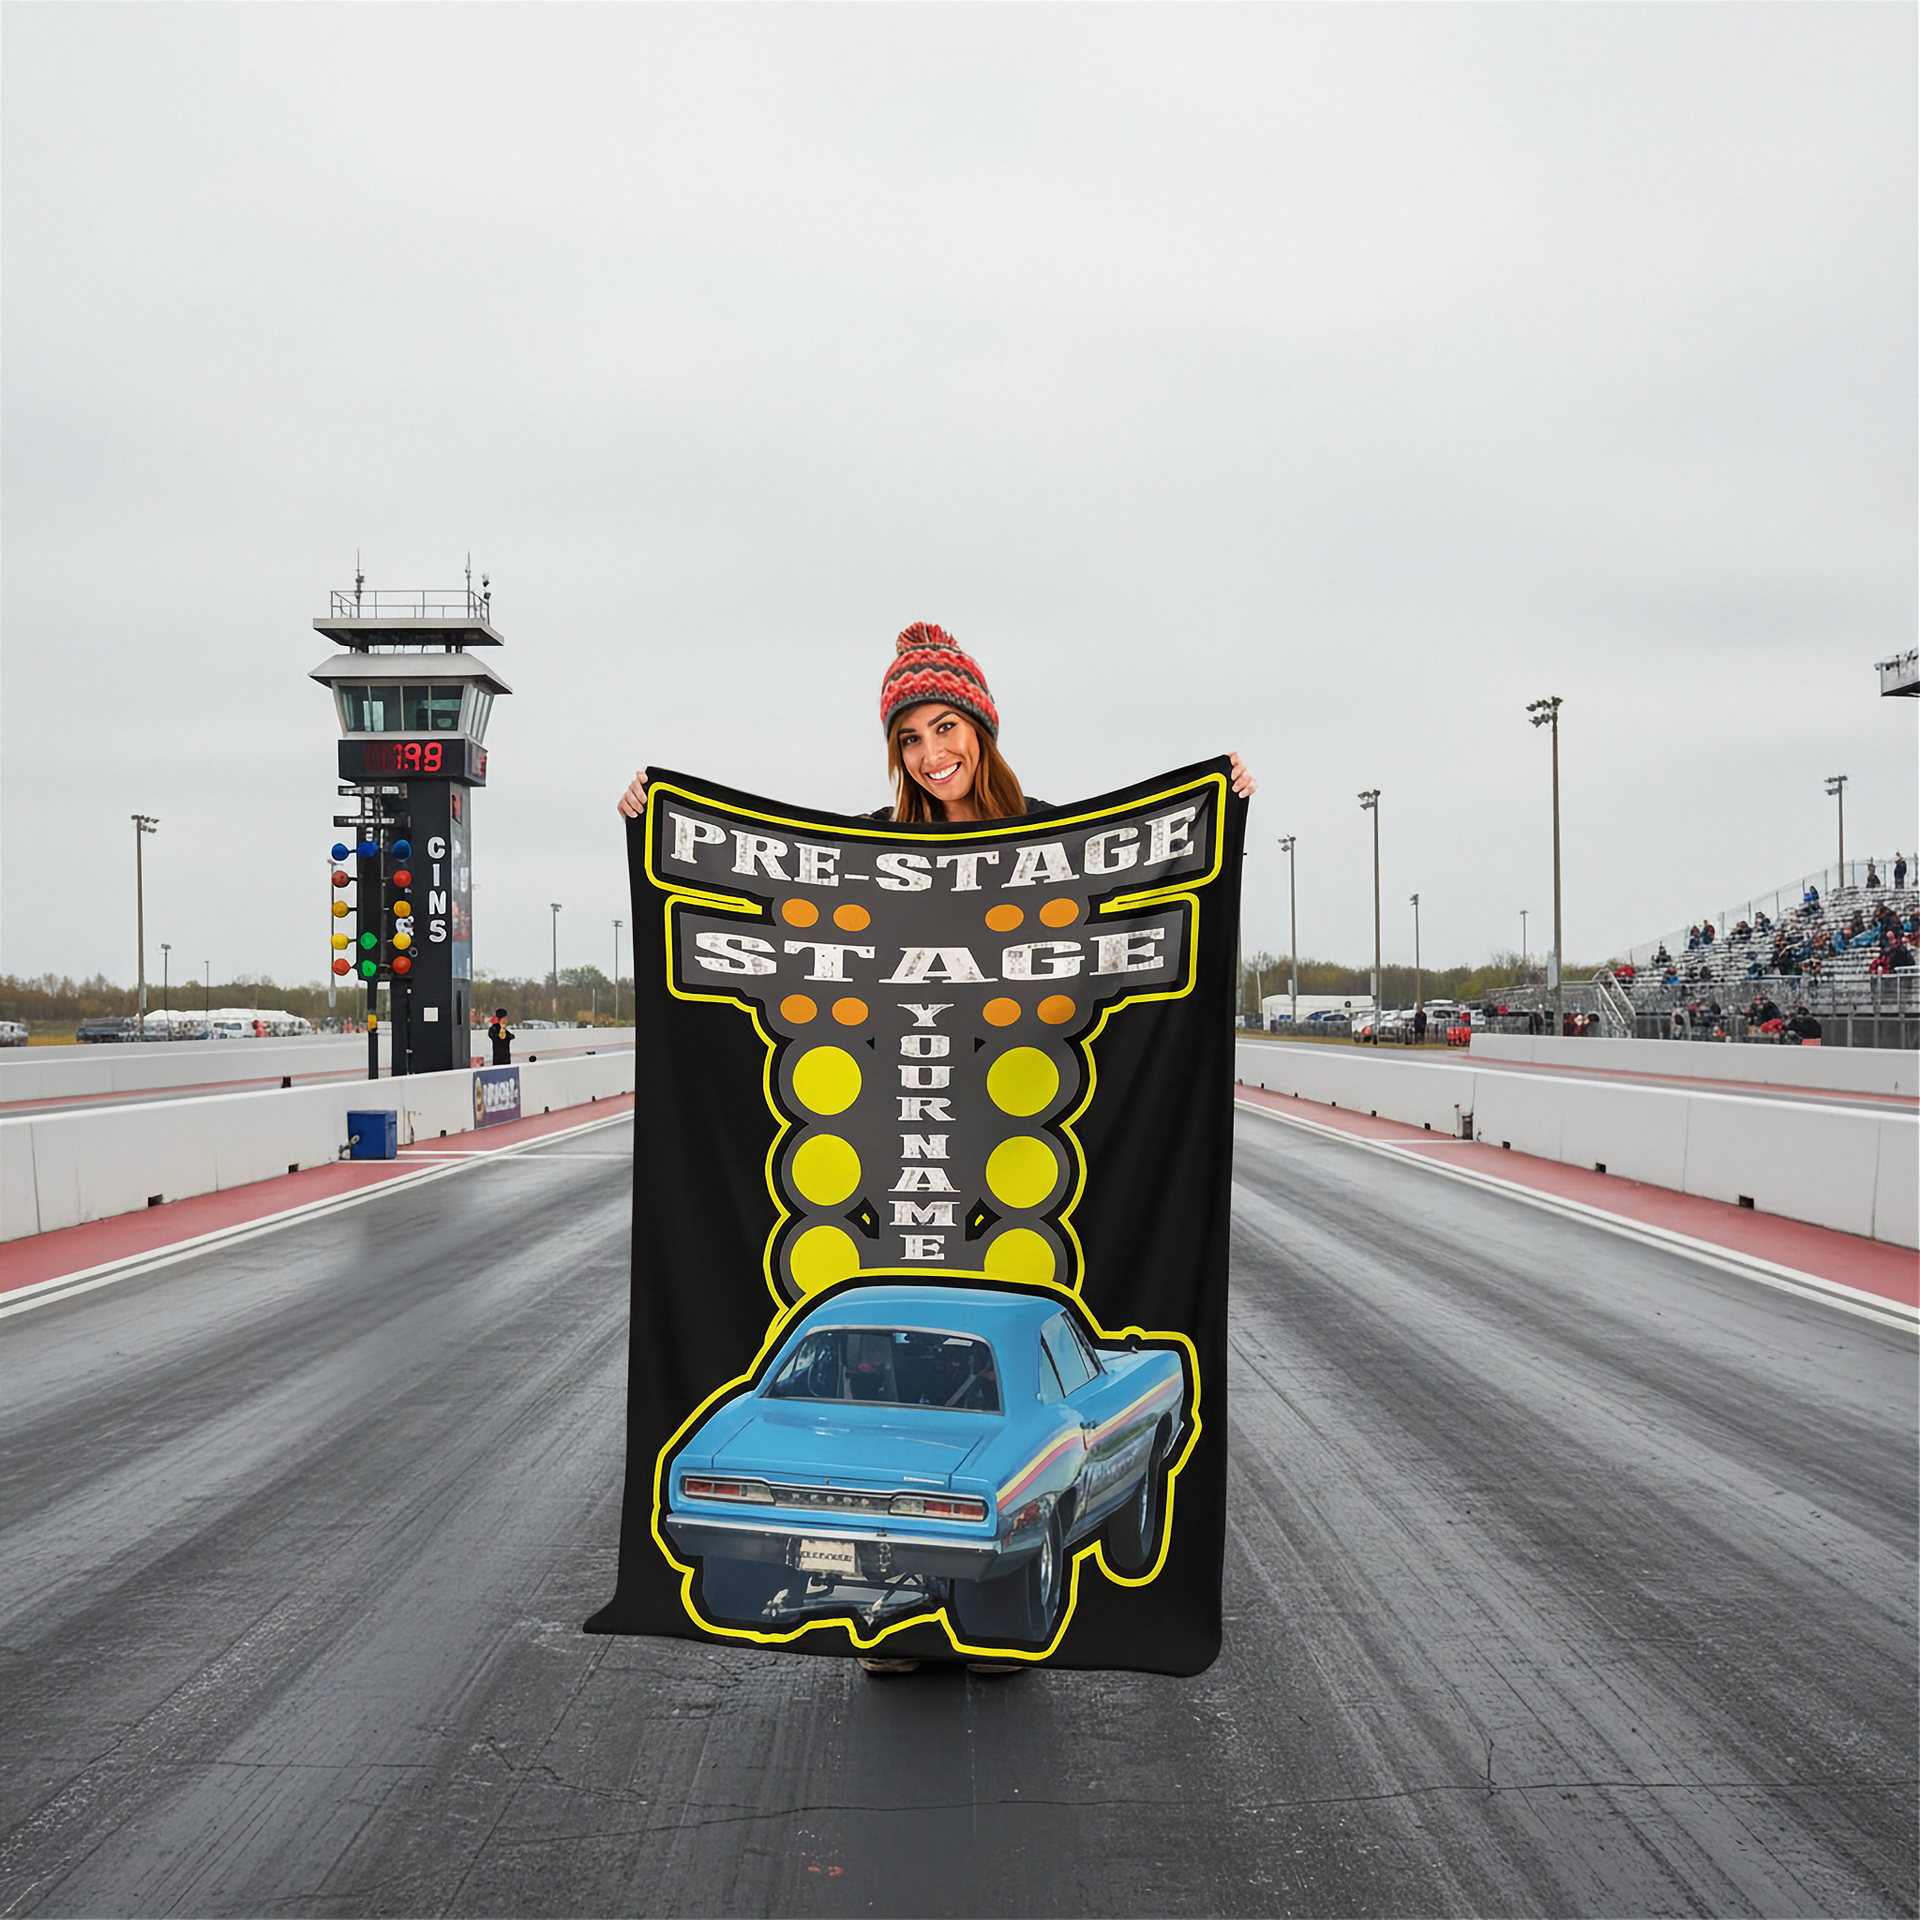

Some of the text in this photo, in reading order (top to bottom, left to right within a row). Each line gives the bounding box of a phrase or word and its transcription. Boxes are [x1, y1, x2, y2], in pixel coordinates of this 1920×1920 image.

[427, 836, 448, 943] CINS
[669, 805, 1197, 892] PRE-STAGE
[695, 927, 1165, 984] STAGE
